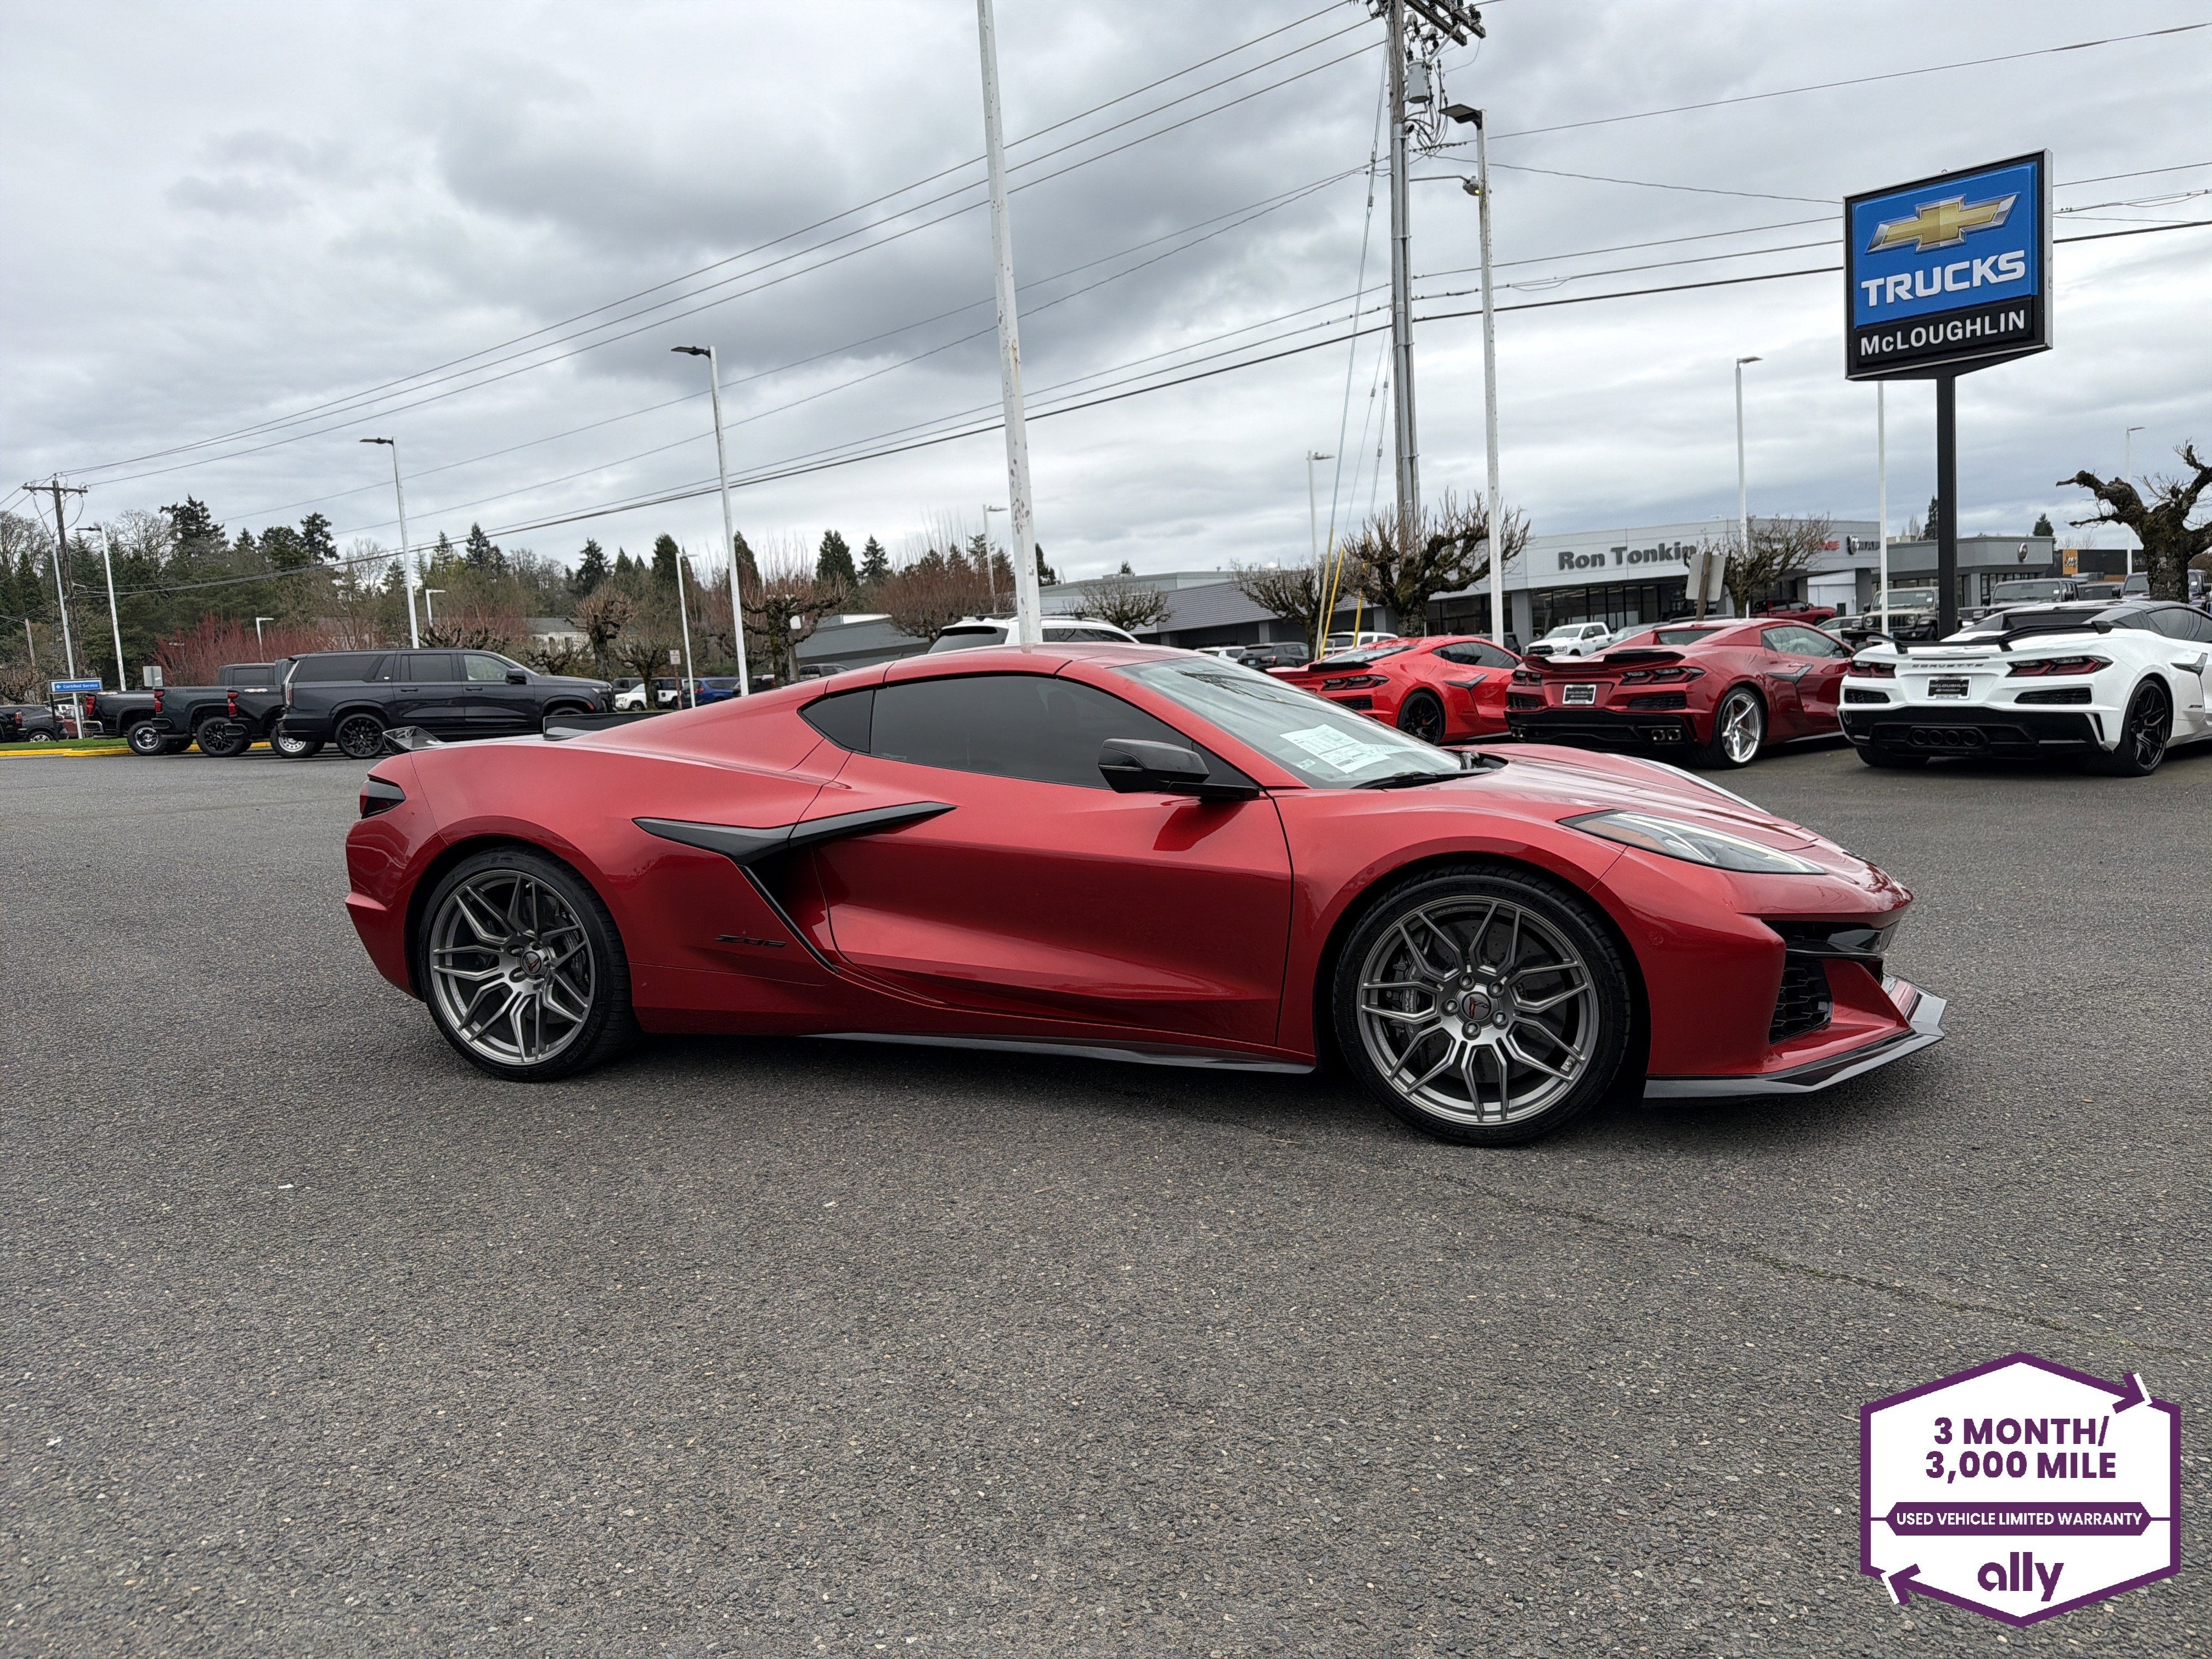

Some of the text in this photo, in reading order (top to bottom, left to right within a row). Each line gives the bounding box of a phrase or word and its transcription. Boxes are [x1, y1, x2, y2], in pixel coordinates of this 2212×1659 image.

[1861, 250, 2025, 307] TRUCKS
[1860, 310, 2025, 356] McLOUGHLIN
[1558, 541, 1697, 571] Ron Tonkin
